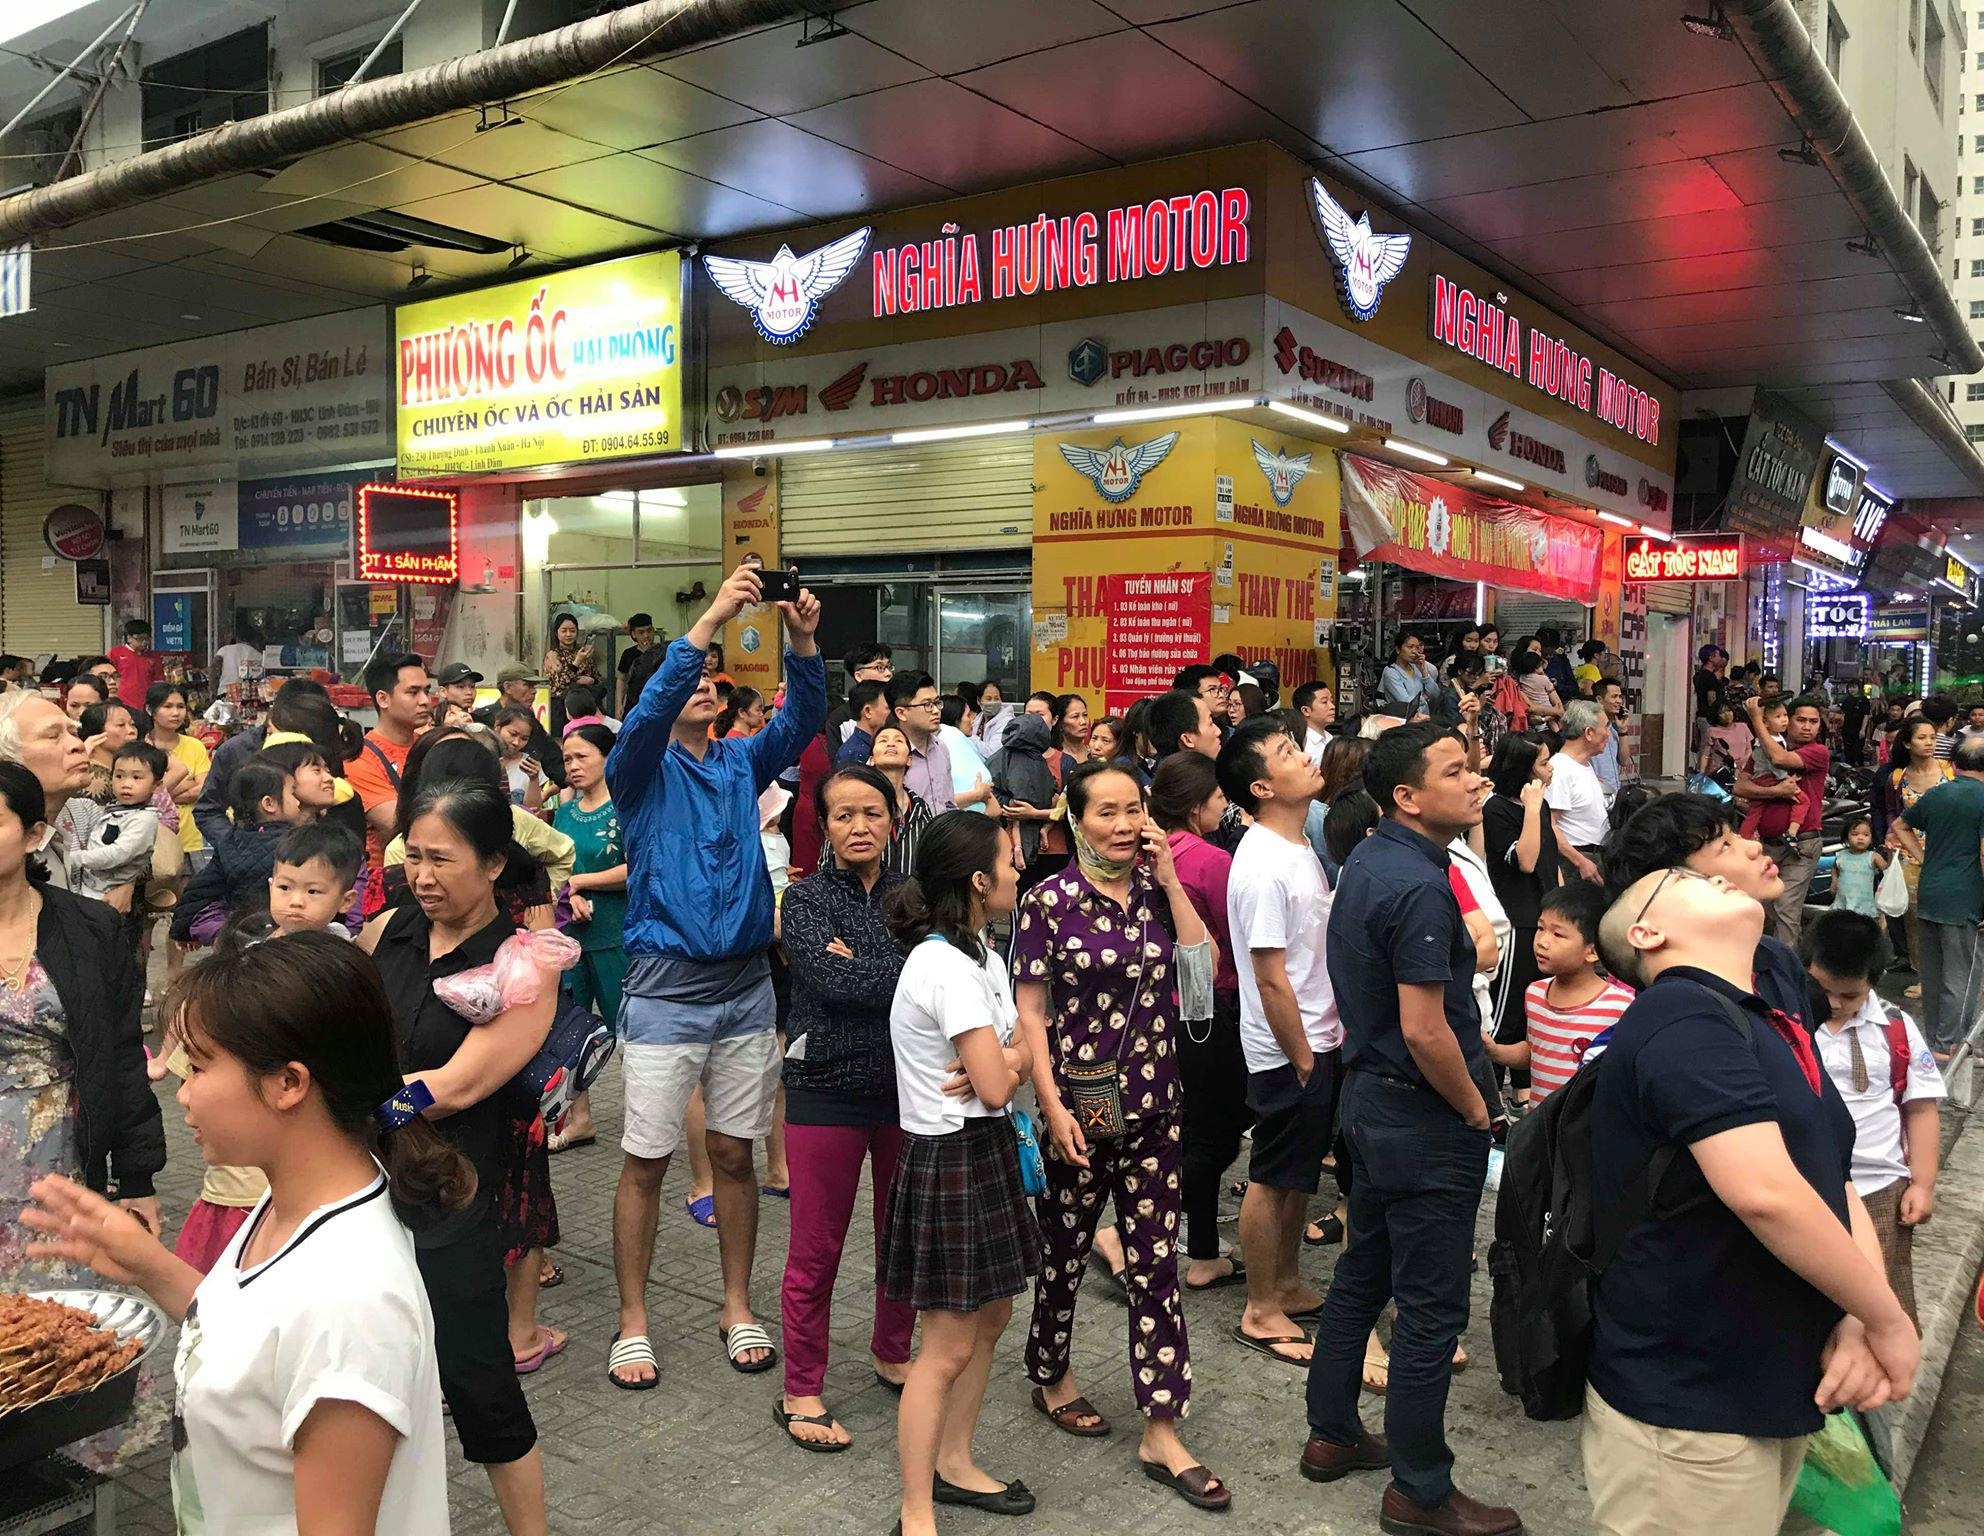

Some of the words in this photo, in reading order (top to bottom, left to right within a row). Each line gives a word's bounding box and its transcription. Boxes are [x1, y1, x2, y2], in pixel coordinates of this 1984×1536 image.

[873, 222, 981, 318] NGHĨA
[992, 213, 1098, 299] HƯNG
[1107, 187, 1249, 283] MOTOR
[1352, 277, 1373, 295] MOTOR
[765, 308, 802, 320] MOTOR
[400, 318, 515, 406] PHƯƠNG
[525, 289, 567, 384] ỐC
[1109, 337, 1250, 380] PIAGGIO
[1434, 274, 1521, 379] NGHĨA
[1529, 328, 1592, 412] HƯNG
[1597, 367, 1660, 446] MOTOR
[244, 359, 277, 393] Bán
[305, 350, 339, 383] Bán
[870, 360, 1046, 406] HONDA
[1298, 346, 1374, 402] SUZUKI
[1204, 381, 1225, 397] LINH
[56, 385, 100, 438] TN
[101, 368, 167, 447] Mart
[173, 365, 219, 422] 60
[412, 410, 478, 437] CHUYÊN
[484, 402, 511, 427] ỐC
[516, 400, 539, 423] VÀ
[546, 394, 573, 419] ỐC
[580, 388, 613, 415] HẢI
[620, 382, 661, 410] SẢN
[741, 384, 808, 423] SYM
[1426, 395, 1464, 435] YAMAHA
[583, 439, 599, 453] ĐT:
[601, 430, 669, 452] 0904.64.55.99
[1509, 431, 1567, 474] HONDA
[1747, 432, 1771, 484] CẮT
[1766, 450, 1789, 494] TÓC
[1103, 477, 1129, 486] MOTOR
[180, 525, 190, 536] TN
[733, 519, 769, 530] HONDA
[1050, 507, 1093, 531] NGHĨA
[1096, 507, 1137, 529] HƯNG
[1141, 505, 1193, 528] MOTOR
[1233, 503, 1265, 528] NGHĨA
[1266, 510, 1292, 532] HƯNG
[1293, 514, 1325, 539] MOTOR
[385, 555, 393, 568] 1
[395, 552, 419, 569] SẢN
[1627, 539, 1661, 578] CẮT
[1662, 544, 1697, 577] TÓC
[1698, 549, 1738, 576] NAM
[1063, 575, 1108, 618] THA
[1124, 574, 1152, 595] TUYỂN
[1153, 576, 1178, 594] NHÂN
[1181, 577, 1195, 597] SỰ
[1238, 573, 1280, 618] THAY
[1286, 568, 1315, 621] THẾ
[1113, 602, 1119, 611] 1.
[1120, 602, 1128, 611] 03
[1152, 601, 1163, 611] kho
[1816, 602, 1861, 623] TÓC
[1113, 617, 1119, 627] 2.
[1119, 617, 1127, 627] 03
[1892, 618, 1911, 627] LAN
[1112, 633, 1119, 643] 3.
[1119, 633, 1127, 643] 03
[1112, 648, 1118, 658] 4.
[1275, 638, 1317, 688] TÙNG
[734, 663, 769, 673] PIAGGIO
[1057, 646, 1106, 695] PHỤ
[1112, 664, 1119, 674] 5.
[1120, 664, 1128, 674] 03
[1129, 664, 1147, 674] Nhân
[1109, 707, 1121, 717] Mr
[392, 1099, 414, 1114] Music
